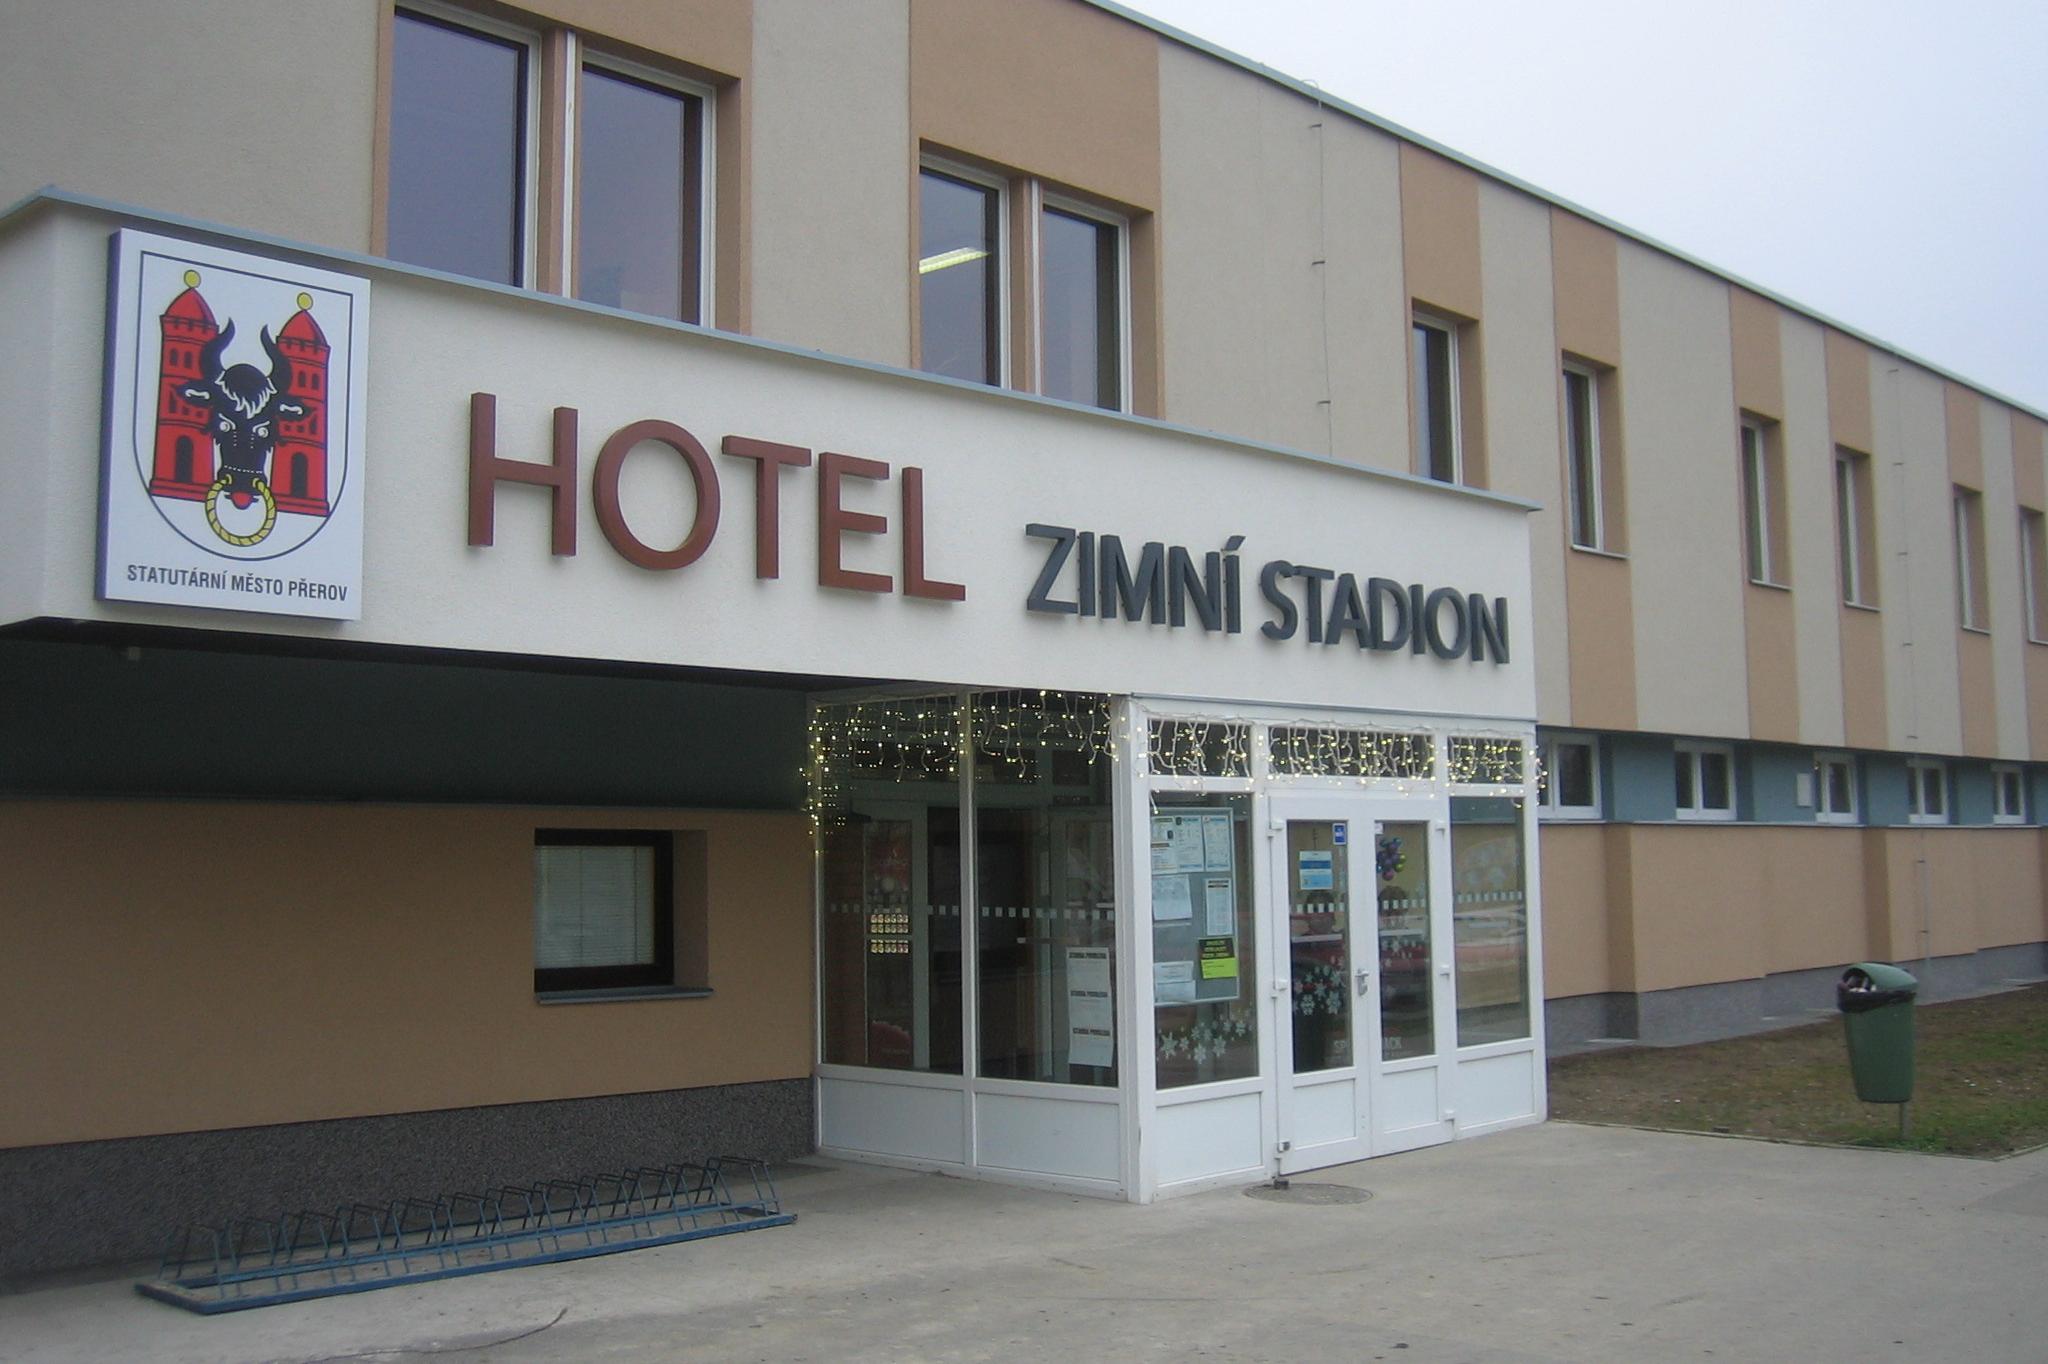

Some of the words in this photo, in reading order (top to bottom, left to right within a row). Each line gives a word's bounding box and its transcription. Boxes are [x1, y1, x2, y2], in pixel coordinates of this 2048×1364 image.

[468, 392, 965, 601] HOTEL
[127, 564, 228, 590] STATUTÁRNÍ
[231, 573, 283, 595] MĚSTO
[288, 578, 348, 601] PŘEROV
[1026, 523, 1246, 634] ZIMNÍ
[1259, 560, 1511, 664] STADION
